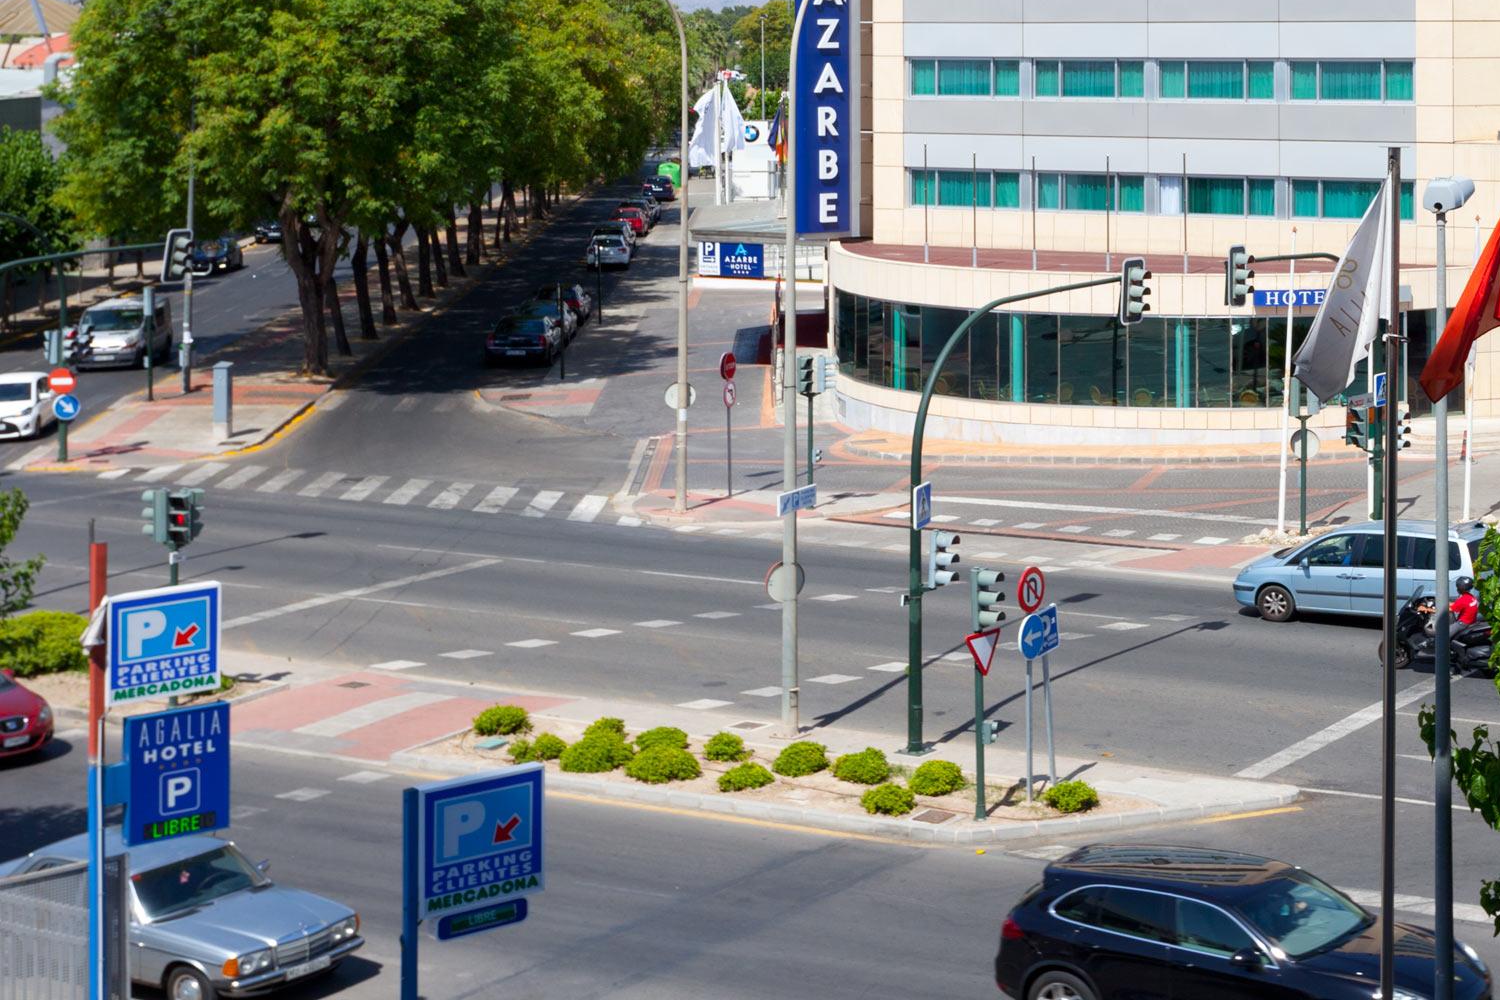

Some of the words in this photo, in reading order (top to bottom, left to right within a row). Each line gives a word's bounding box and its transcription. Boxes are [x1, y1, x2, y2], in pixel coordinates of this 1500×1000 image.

[704, 241, 714, 256] P
[724, 256, 758, 264] AZARBE
[730, 263, 751, 271] HOTEL
[1265, 290, 1325, 305] HOTE
[126, 609, 167, 658] P
[117, 653, 211, 677] PARKING
[117, 663, 211, 687] CLIENTES
[114, 674, 216, 700] MERCADONA
[139, 710, 221, 747] AGALIA
[143, 739, 216, 764] HOTEL
[167, 776, 192, 808] P
[152, 814, 200, 839] LIBRE
[443, 800, 486, 858] P
[432, 850, 532, 882] PARKING
[432, 862, 532, 893] CLIENTES
[428, 875, 539, 912] MERCADONA
